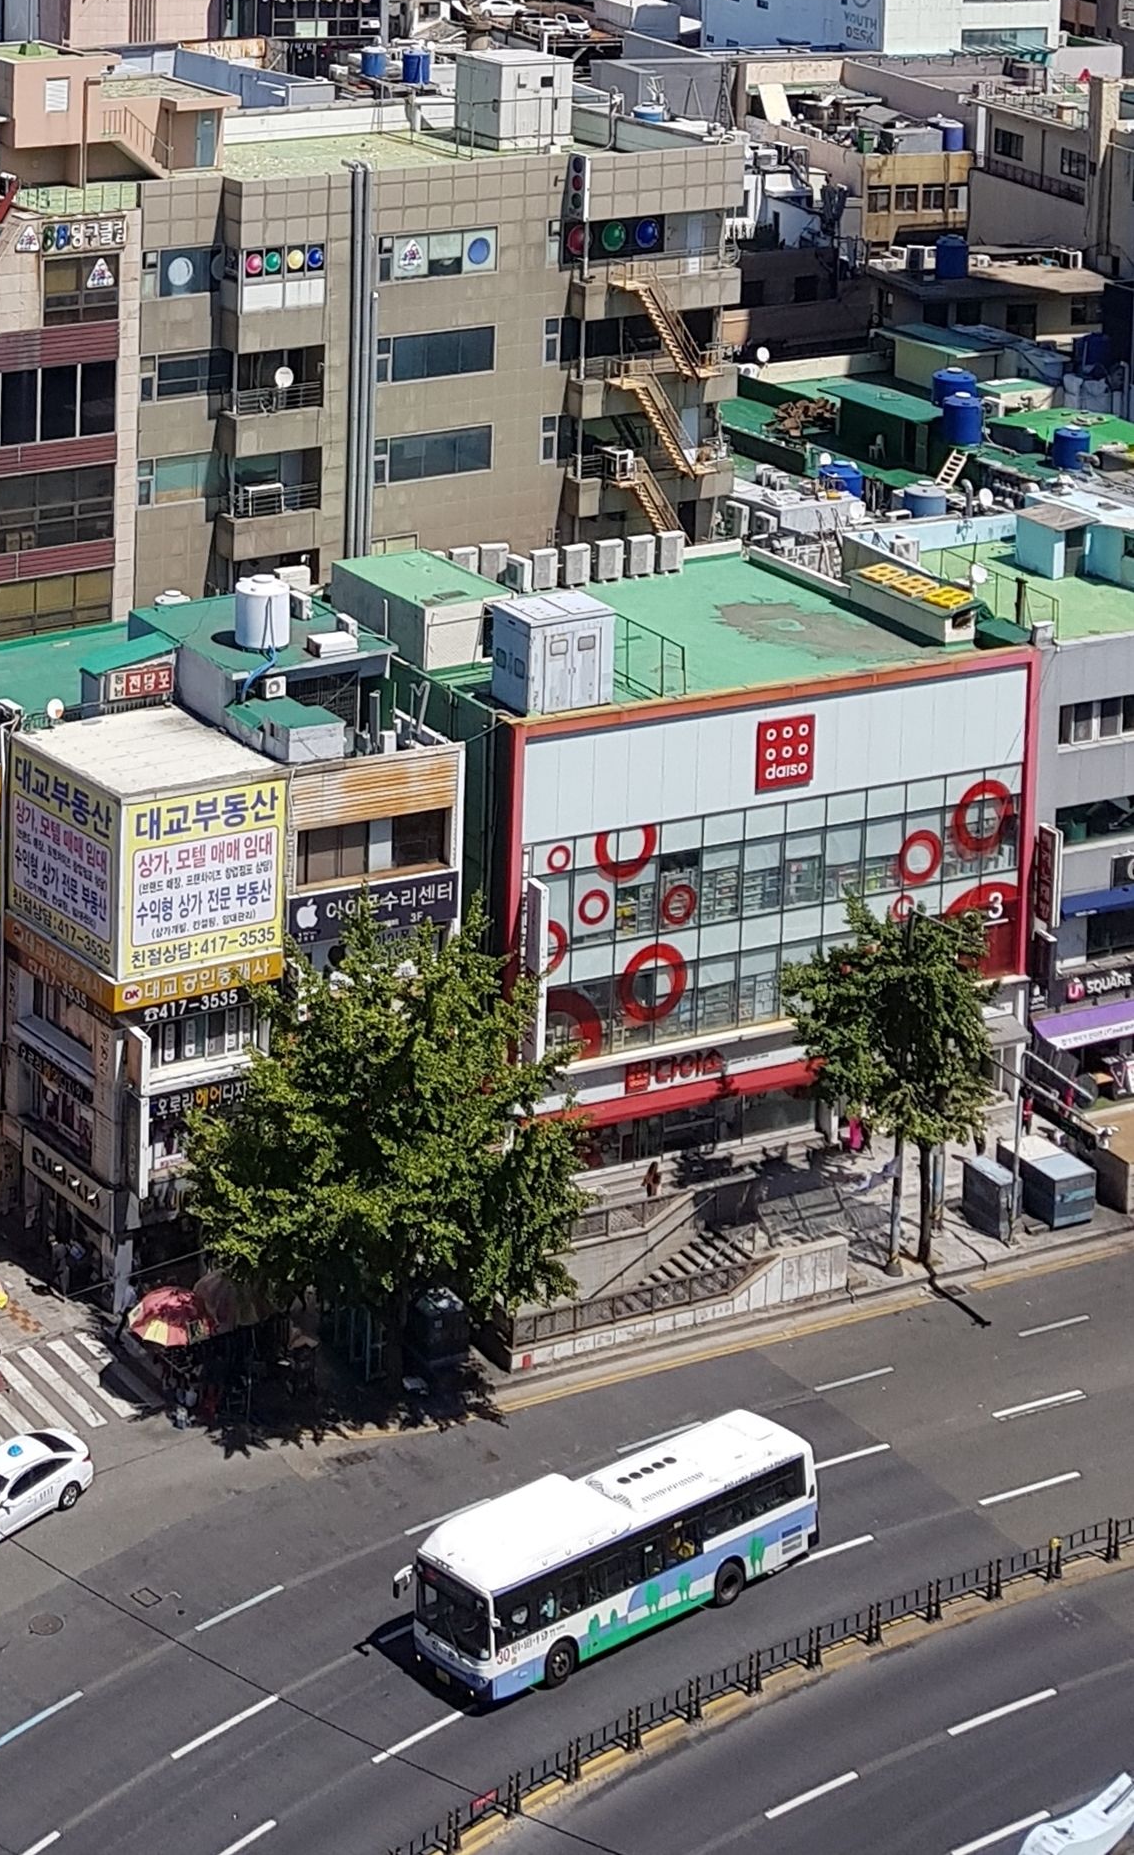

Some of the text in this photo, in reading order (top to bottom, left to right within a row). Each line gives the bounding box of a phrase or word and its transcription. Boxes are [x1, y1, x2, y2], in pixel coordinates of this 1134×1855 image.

[844, 11, 877, 30] YOUTH
[846, 26, 874, 44] DESK
[129, 671, 170, 695] 전당포
[766, 763, 808, 780] daiso
[15, 756, 112, 839] 대교부동산
[135, 787, 278, 840] 대교부동산
[16, 799, 38, 834] 상가,
[40, 816, 61, 846] 모텔
[86, 842, 107, 875] 임대
[138, 832, 273, 879] 상가, 모텔 매매 임대
[15, 847, 107, 921] 수익형 상가 전문 부동산
[136, 877, 272, 928] 수익형 상가 전문 부동산
[988, 892, 1003, 920] 3
[410, 911, 424, 923] 3F
[124, 989, 140, 1001] DK
[1087, 973, 1132, 994] SQUARE
[159, 989, 239, 1016] 417-3535
[654, 1049, 724, 1085] 다이소
[157, 1081, 254, 1116] 오로라헤어디자
[497, 1648, 510, 1665] 30
